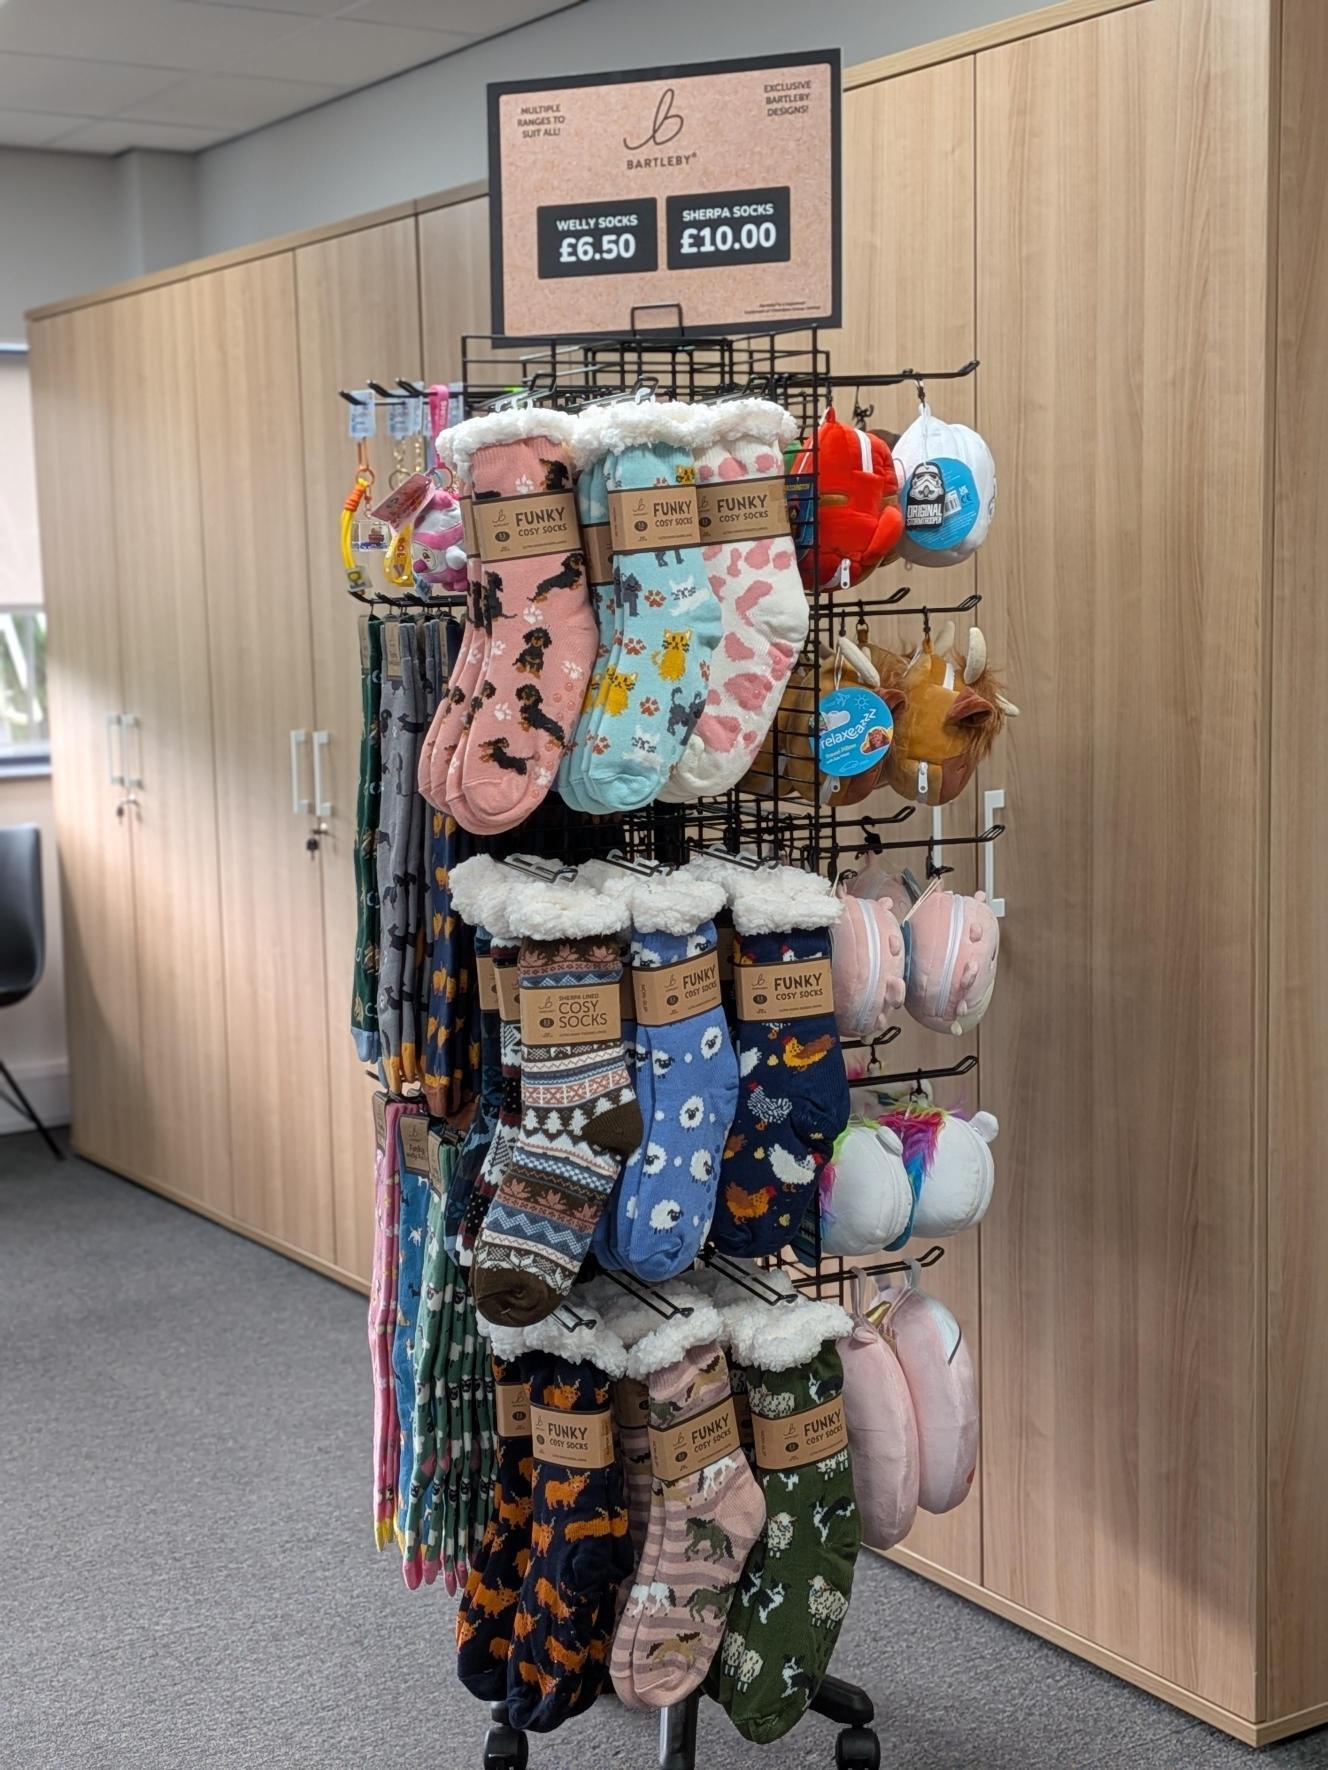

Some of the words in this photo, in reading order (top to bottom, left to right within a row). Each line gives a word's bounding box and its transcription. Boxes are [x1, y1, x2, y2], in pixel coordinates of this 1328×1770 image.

[764, 80, 812, 93] EXCLUSIVE
[766, 92, 810, 105] BARTLEBY
[521, 104, 561, 115] MULTIPLE
[767, 105, 809, 117] DESIGNS!
[517, 117, 551, 127] RANGES
[553, 115, 565, 125] TO
[522, 128, 541, 138] SUIT
[543, 127, 561, 137] ALL!
[682, 207, 731, 222] SHERPA
[733, 203, 775, 217] SOCKS
[556, 218, 597, 232] WELLY
[598, 214, 639, 229] SOCKS
[680, 221, 777, 254] £10.00
[559, 232, 637, 263] £6.50
[653, 500, 693, 518] FUNKY
[717, 494, 768, 513] FUNKY
[907, 503, 942, 518] ORIGINAL
[515, 506, 566, 527] FUNKY
[655, 519, 674, 528] COSY
[675, 516, 694, 526] SOCKS
[719, 513, 741, 523] COSY
[743, 510, 769, 520] SOCKS
[518, 527, 540, 537] COSY
[542, 522, 568, 534] SOCKS
[683, 965, 716, 989] FUNKY
[774, 972, 823, 991] FUNKY
[684, 987, 701, 999] COSY
[701, 981, 718, 993] SOCKS
[775, 991, 798, 1001] COSY
[799, 988, 824, 999] SOCKS
[558, 1000, 599, 1015] COSY
[558, 1013, 608, 1029] SOCKS
[691, 1412, 729, 1444] FUNKY
[804, 1408, 841, 1437] FUNKY
[548, 1422, 588, 1440] FUNKY
[550, 1438, 565, 1447] COSY
[566, 1441, 589, 1450] SOCKS
[694, 1440, 712, 1453] COSY
[713, 1427, 732, 1444] SOCKS
[806, 1434, 824, 1446] COSY
